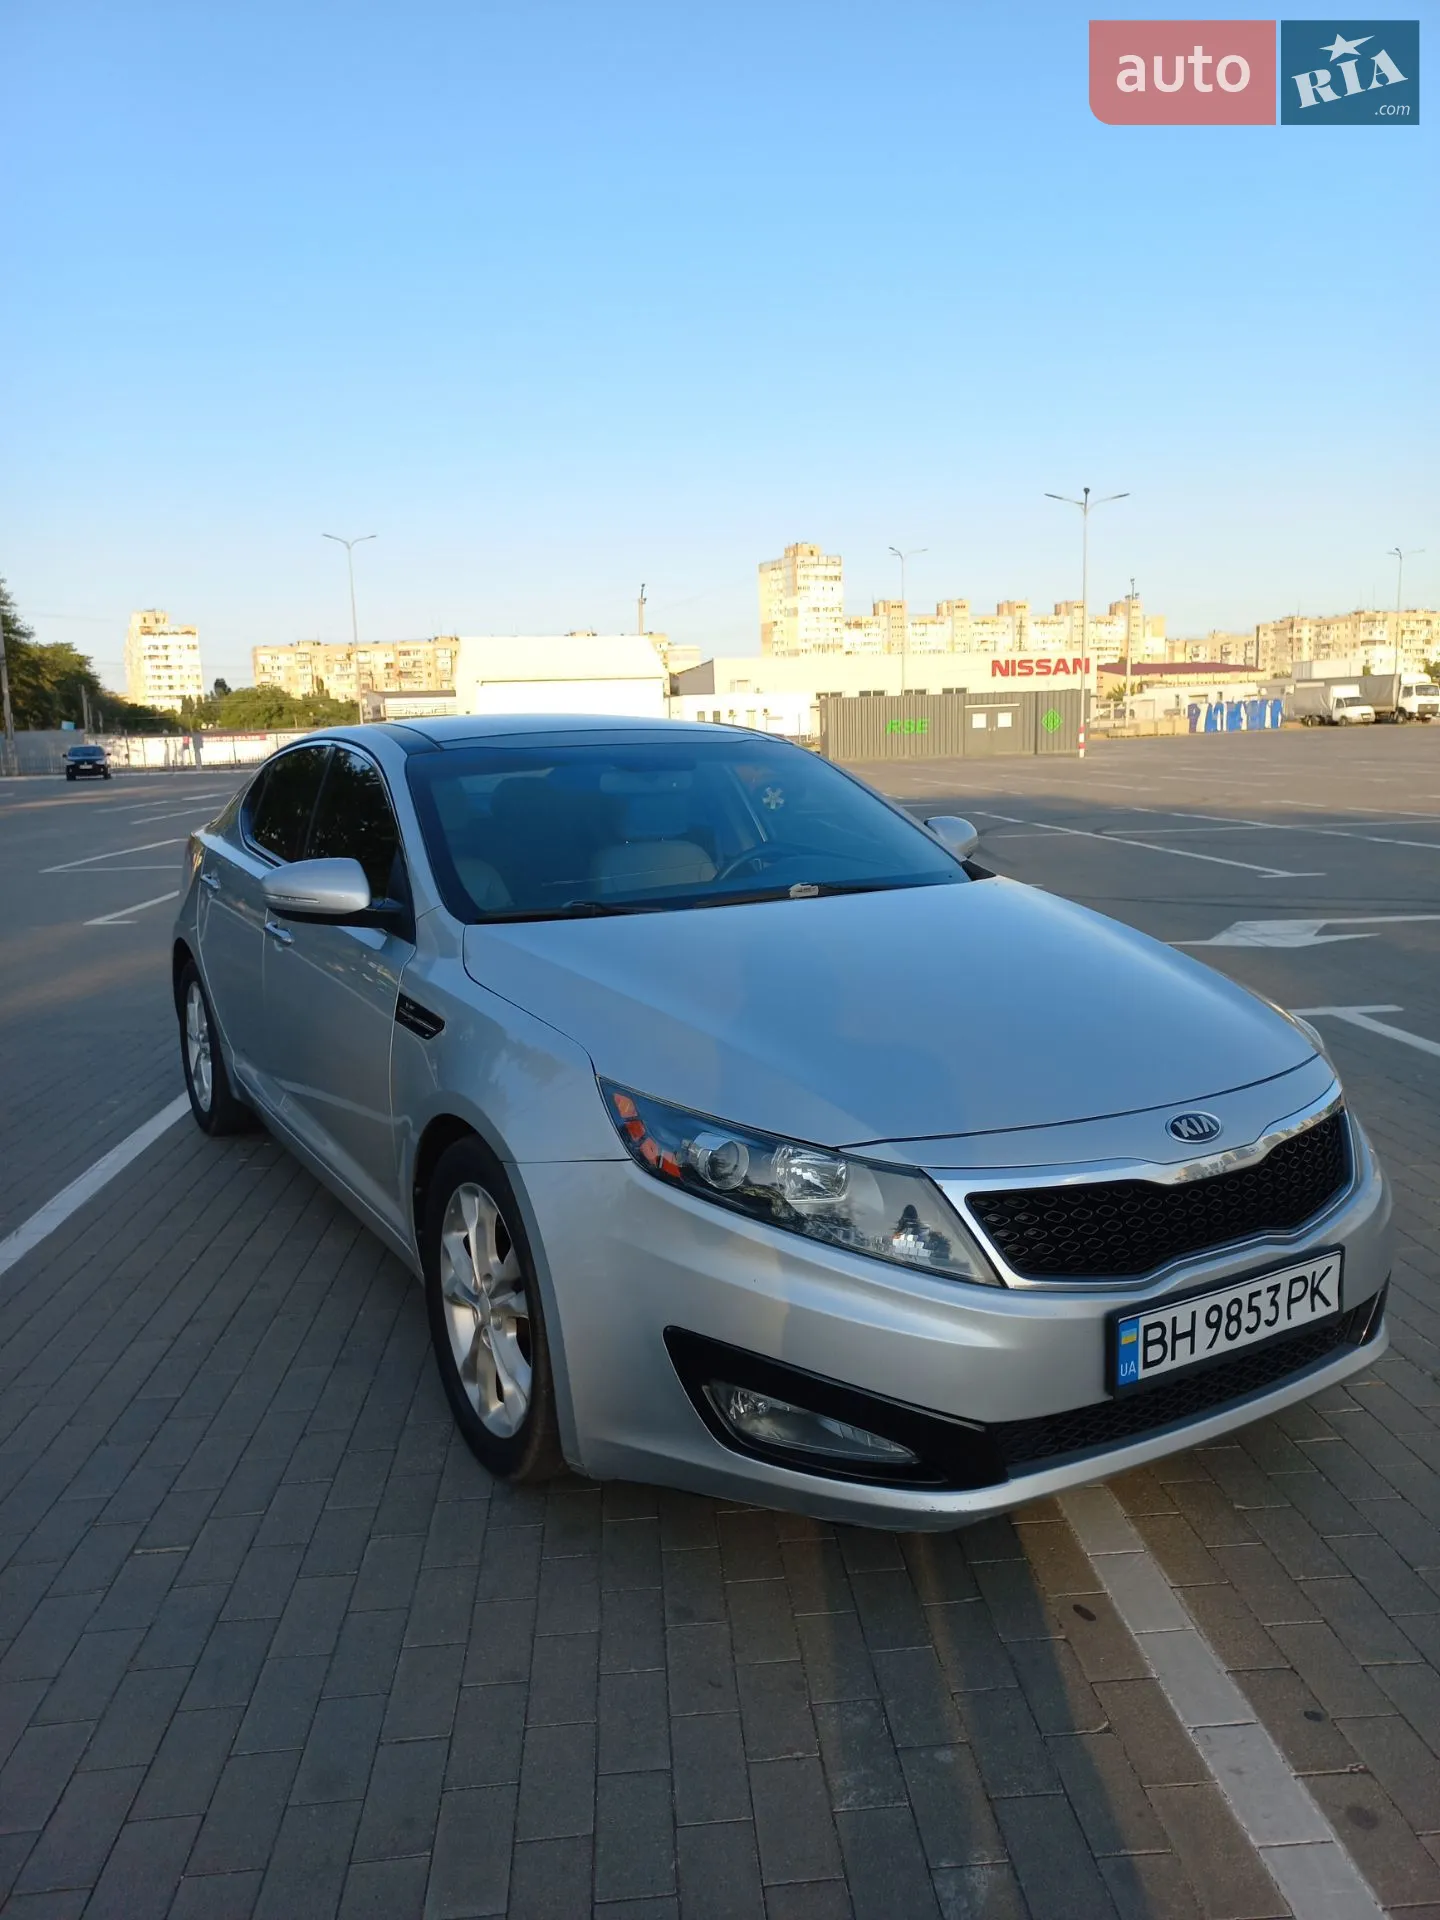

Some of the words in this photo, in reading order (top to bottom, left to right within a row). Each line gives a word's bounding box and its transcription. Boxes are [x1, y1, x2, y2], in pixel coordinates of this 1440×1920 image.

[991, 657, 1090, 677] NISSAN
[1174, 1115, 1217, 1138] KIA
[1142, 1310, 1197, 1370] BH
[1204, 1283, 1281, 1350] 9853
[1286, 1265, 1333, 1320] PK
[1120, 1360, 1137, 1377] UA
